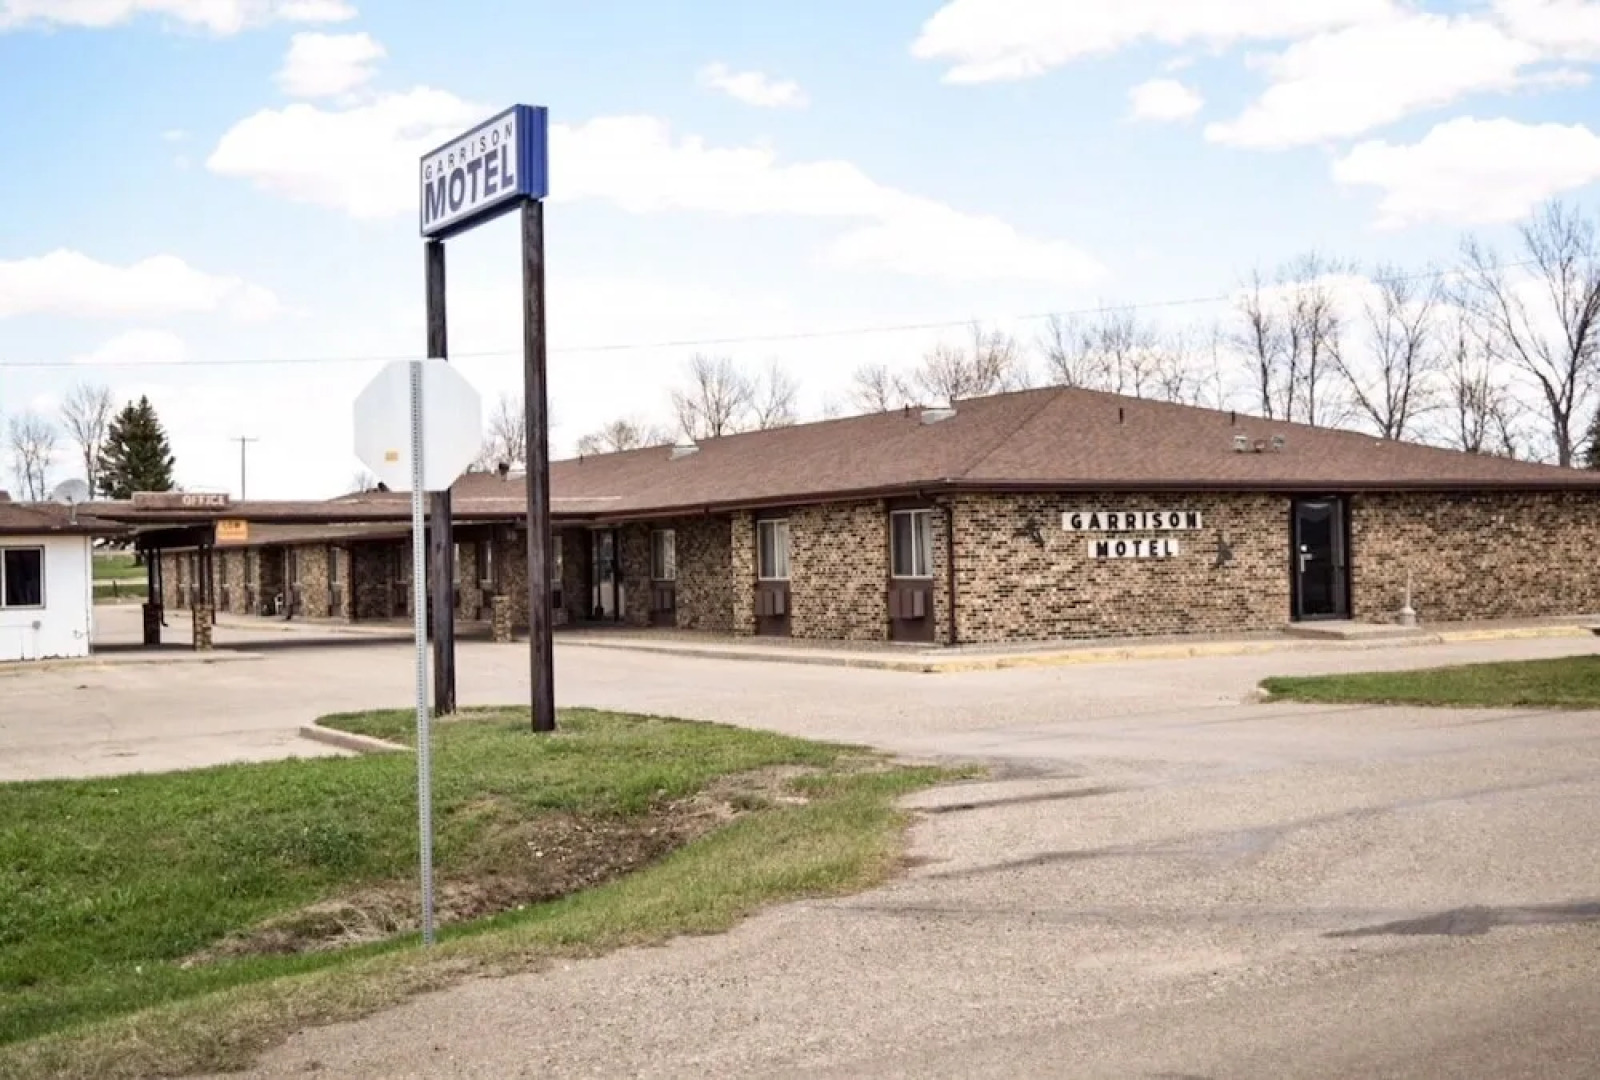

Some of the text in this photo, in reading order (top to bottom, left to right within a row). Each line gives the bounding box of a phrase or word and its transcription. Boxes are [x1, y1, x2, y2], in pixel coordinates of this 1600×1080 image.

[425, 121, 512, 180] GARRISON
[425, 143, 514, 224] MOTEL
[182, 495, 225, 506] OFFICE
[1071, 513, 1197, 529] GARRISON
[1096, 540, 1174, 556] MOTEL
